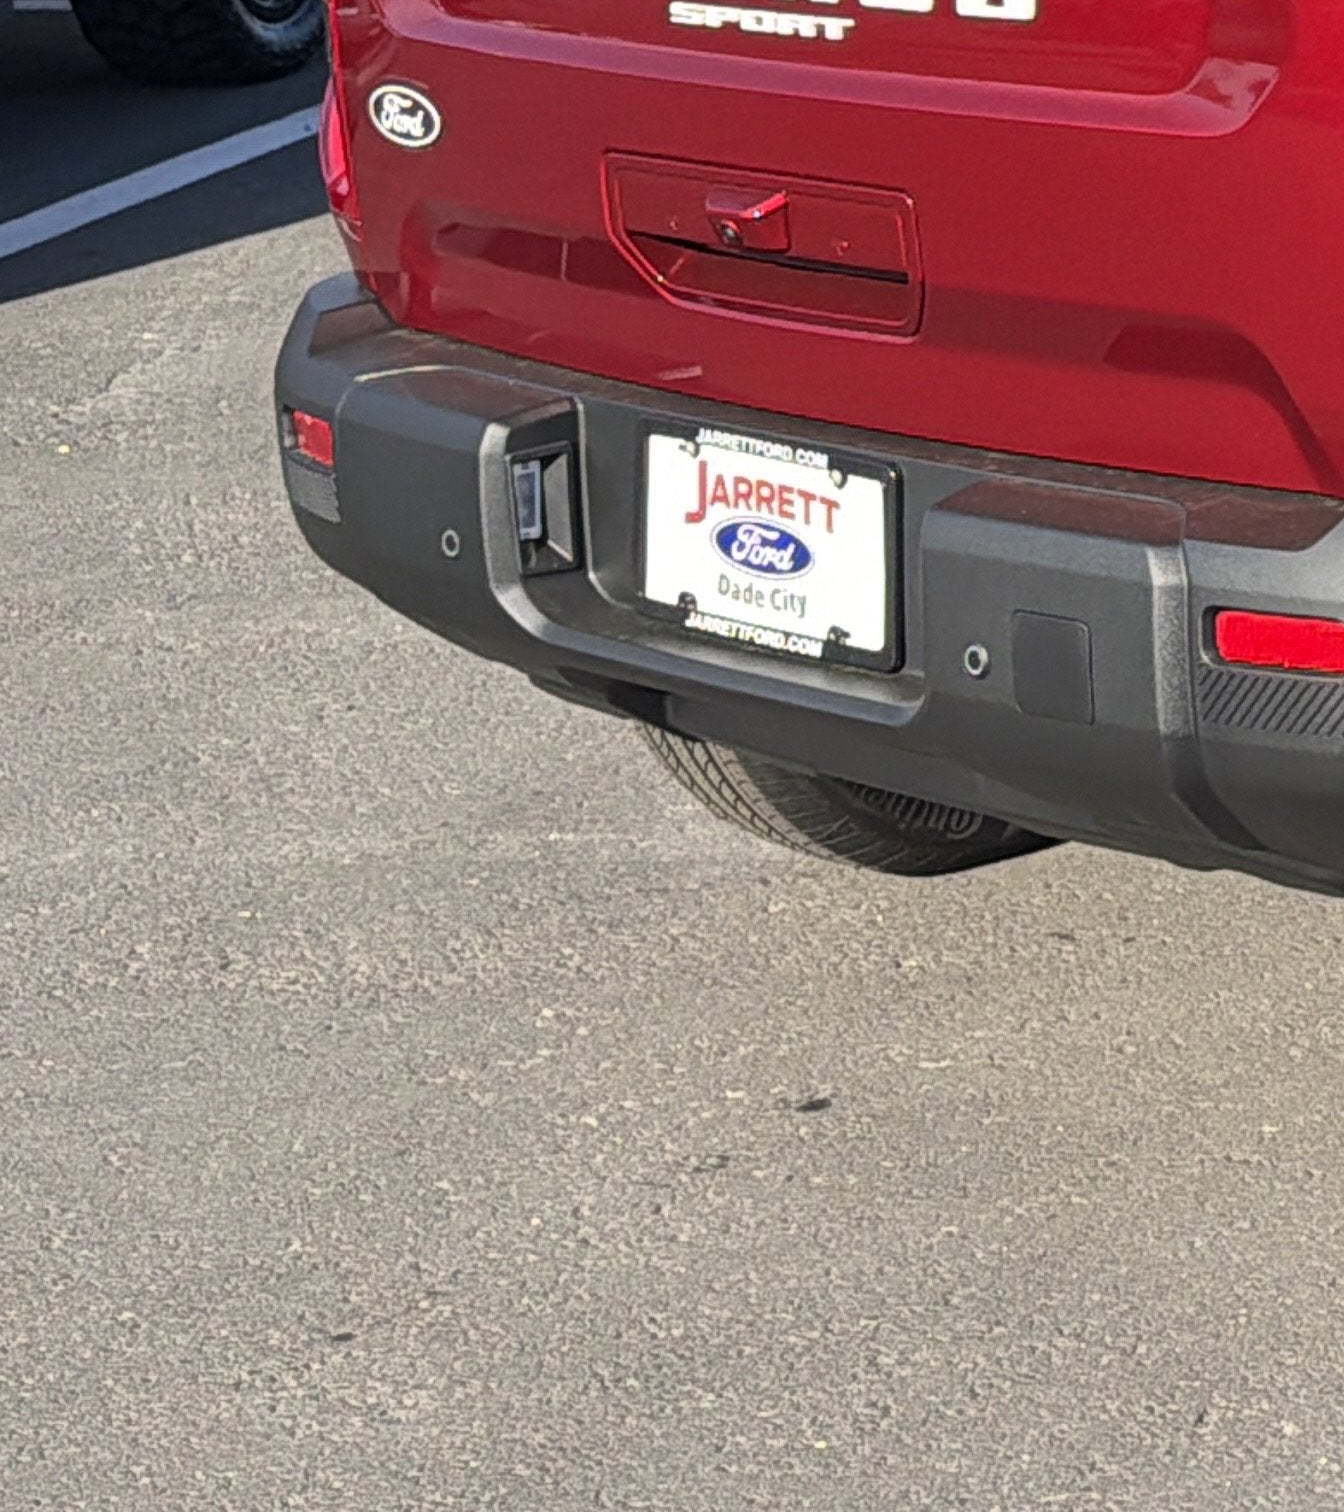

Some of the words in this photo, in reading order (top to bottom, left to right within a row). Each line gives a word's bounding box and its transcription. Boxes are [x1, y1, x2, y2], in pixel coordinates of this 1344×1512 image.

[669, 0, 855, 41] SPORT
[381, 92, 425, 138] Ford
[695, 428, 829, 471] JARRETTFORD.COM
[684, 459, 841, 534] JARRETT
[730, 523, 797, 571] Ford
[717, 572, 765, 607] Dade
[769, 587, 808, 618] City
[684, 611, 824, 658] JARRETTFORD.COM
